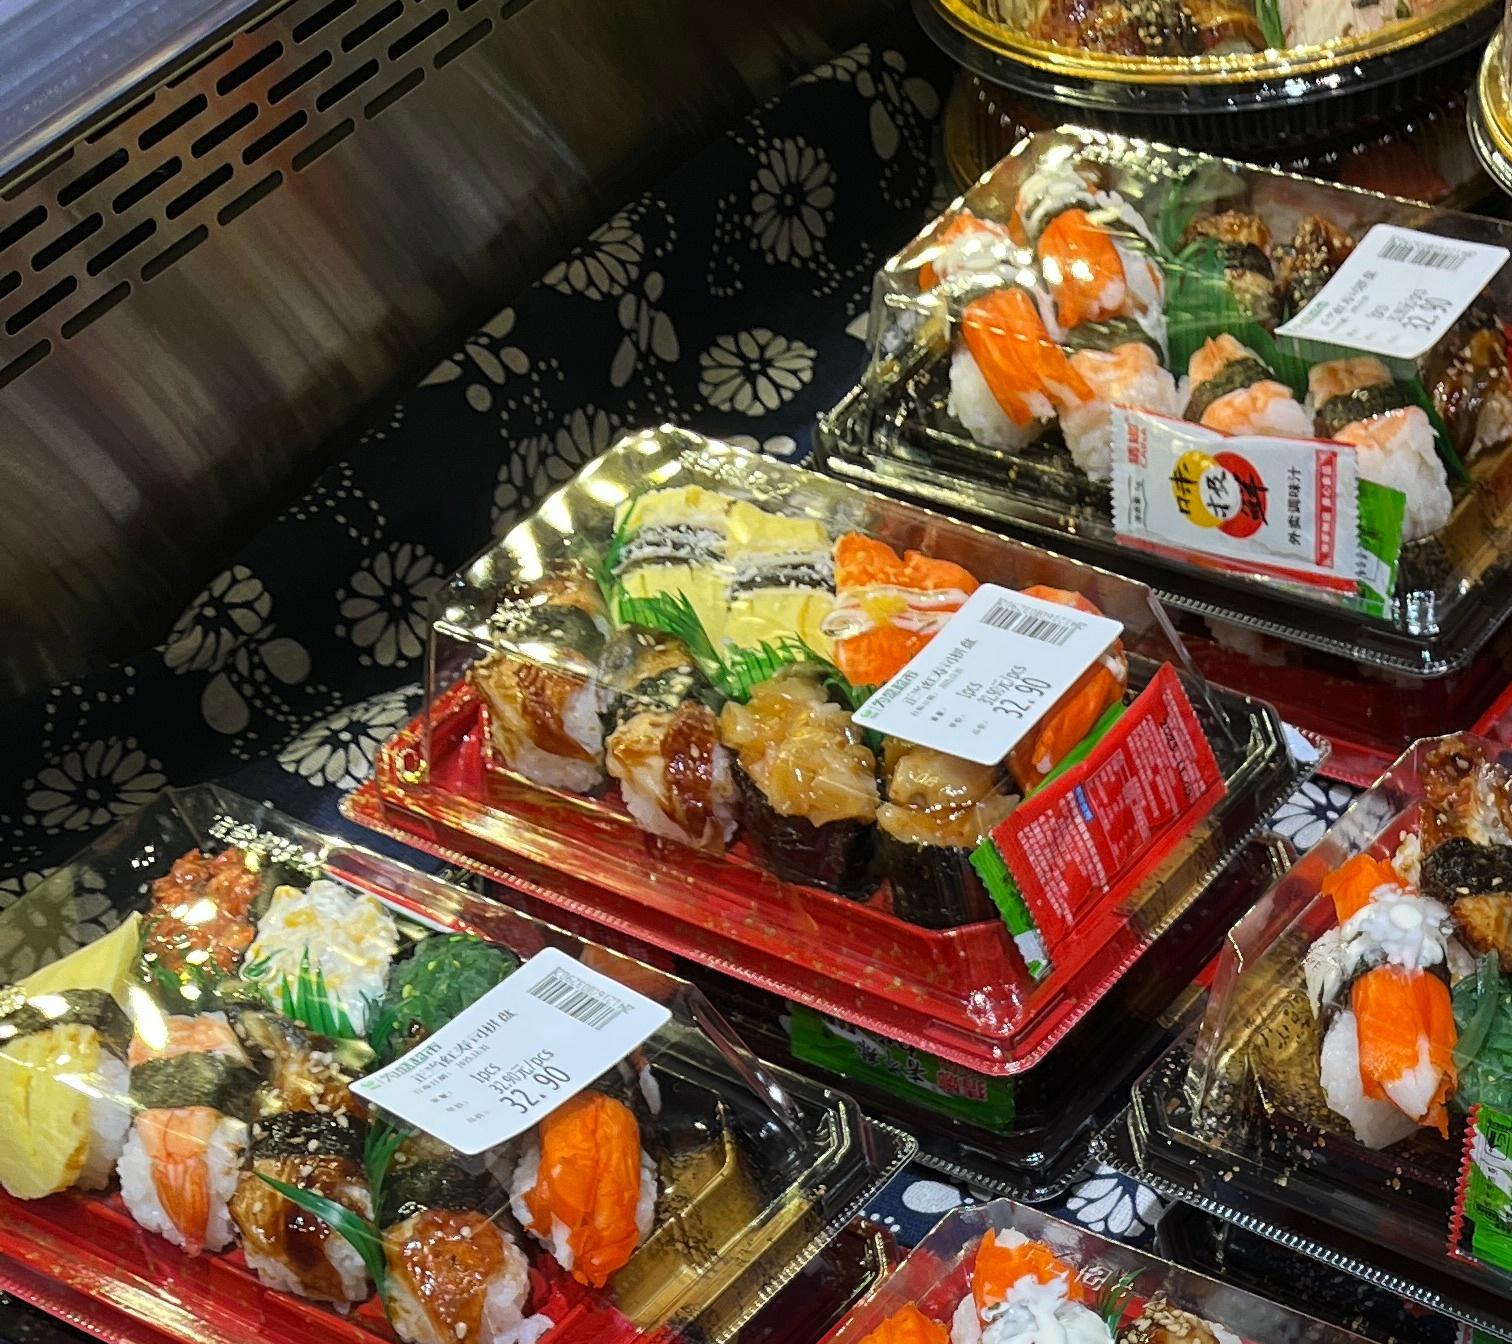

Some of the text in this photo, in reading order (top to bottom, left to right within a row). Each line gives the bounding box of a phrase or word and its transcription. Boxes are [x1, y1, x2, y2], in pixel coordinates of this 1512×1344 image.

[1169, 462, 1269, 526] 味极鲜
[991, 676, 1052, 719] 32.90
[468, 1062, 501, 1084] 1pcs
[498, 1065, 571, 1114] 32.90
